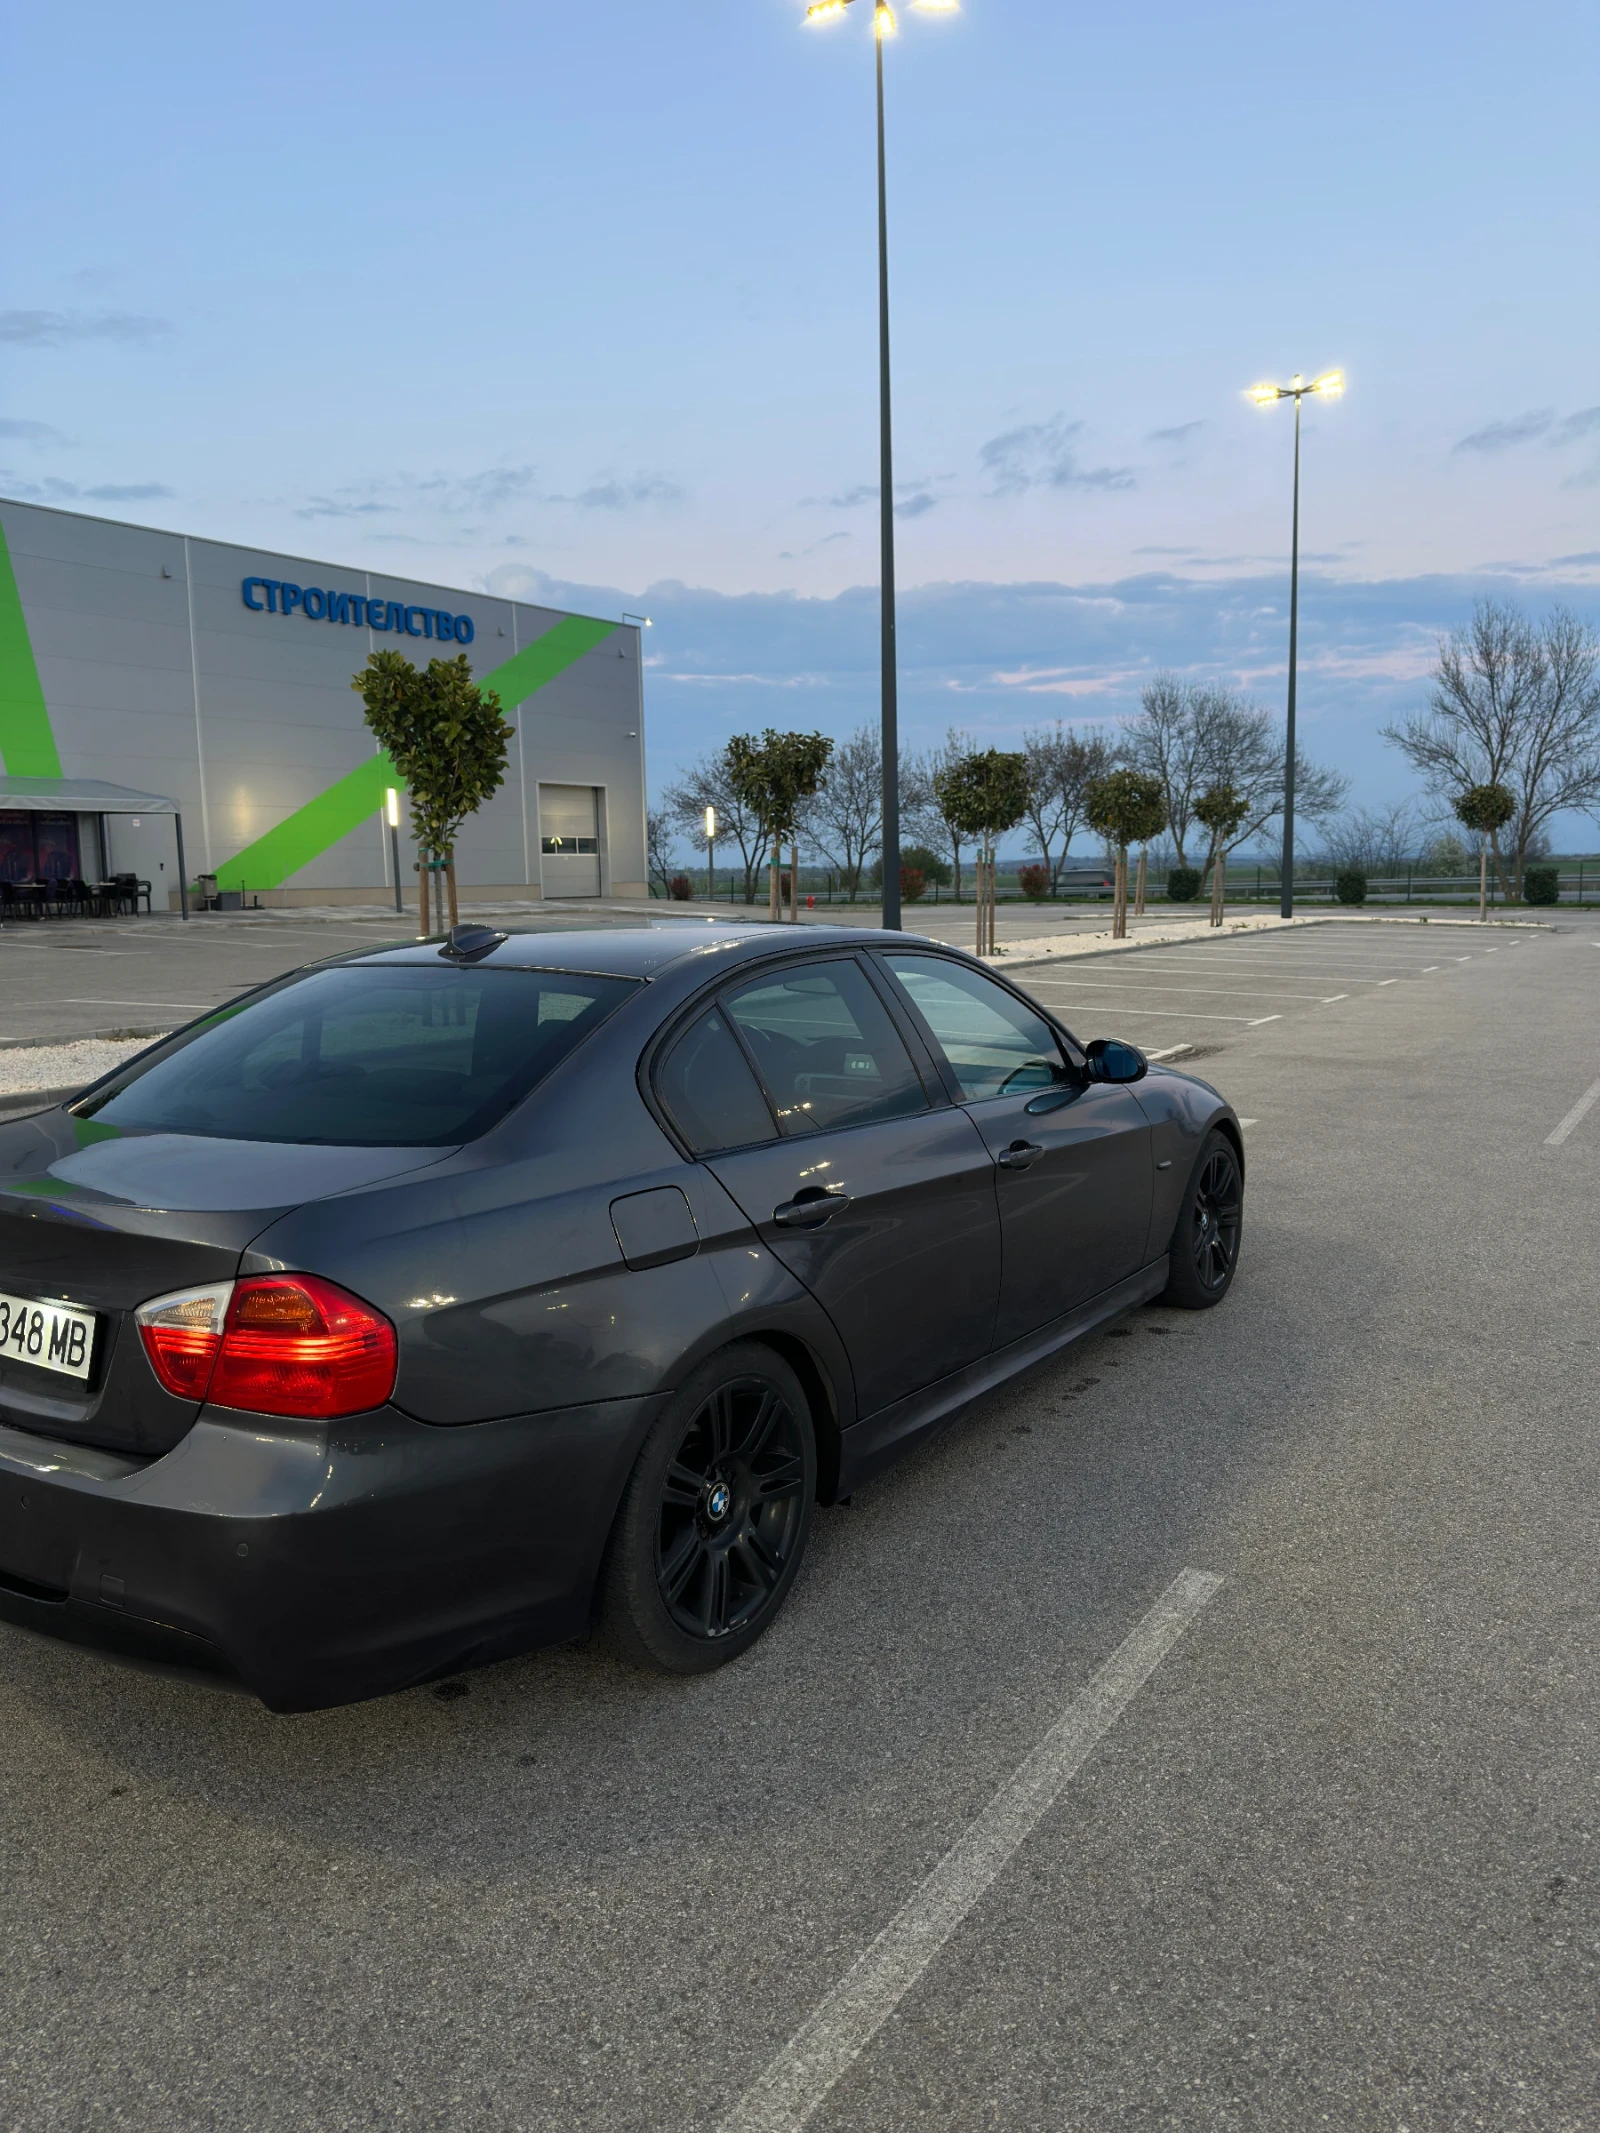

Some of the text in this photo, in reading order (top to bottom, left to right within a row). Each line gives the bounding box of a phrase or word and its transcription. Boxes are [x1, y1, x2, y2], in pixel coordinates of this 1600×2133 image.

[242, 576, 475, 645] СТРОИТЕЛСТВО
[0, 1302, 87, 1368] 348 MB
